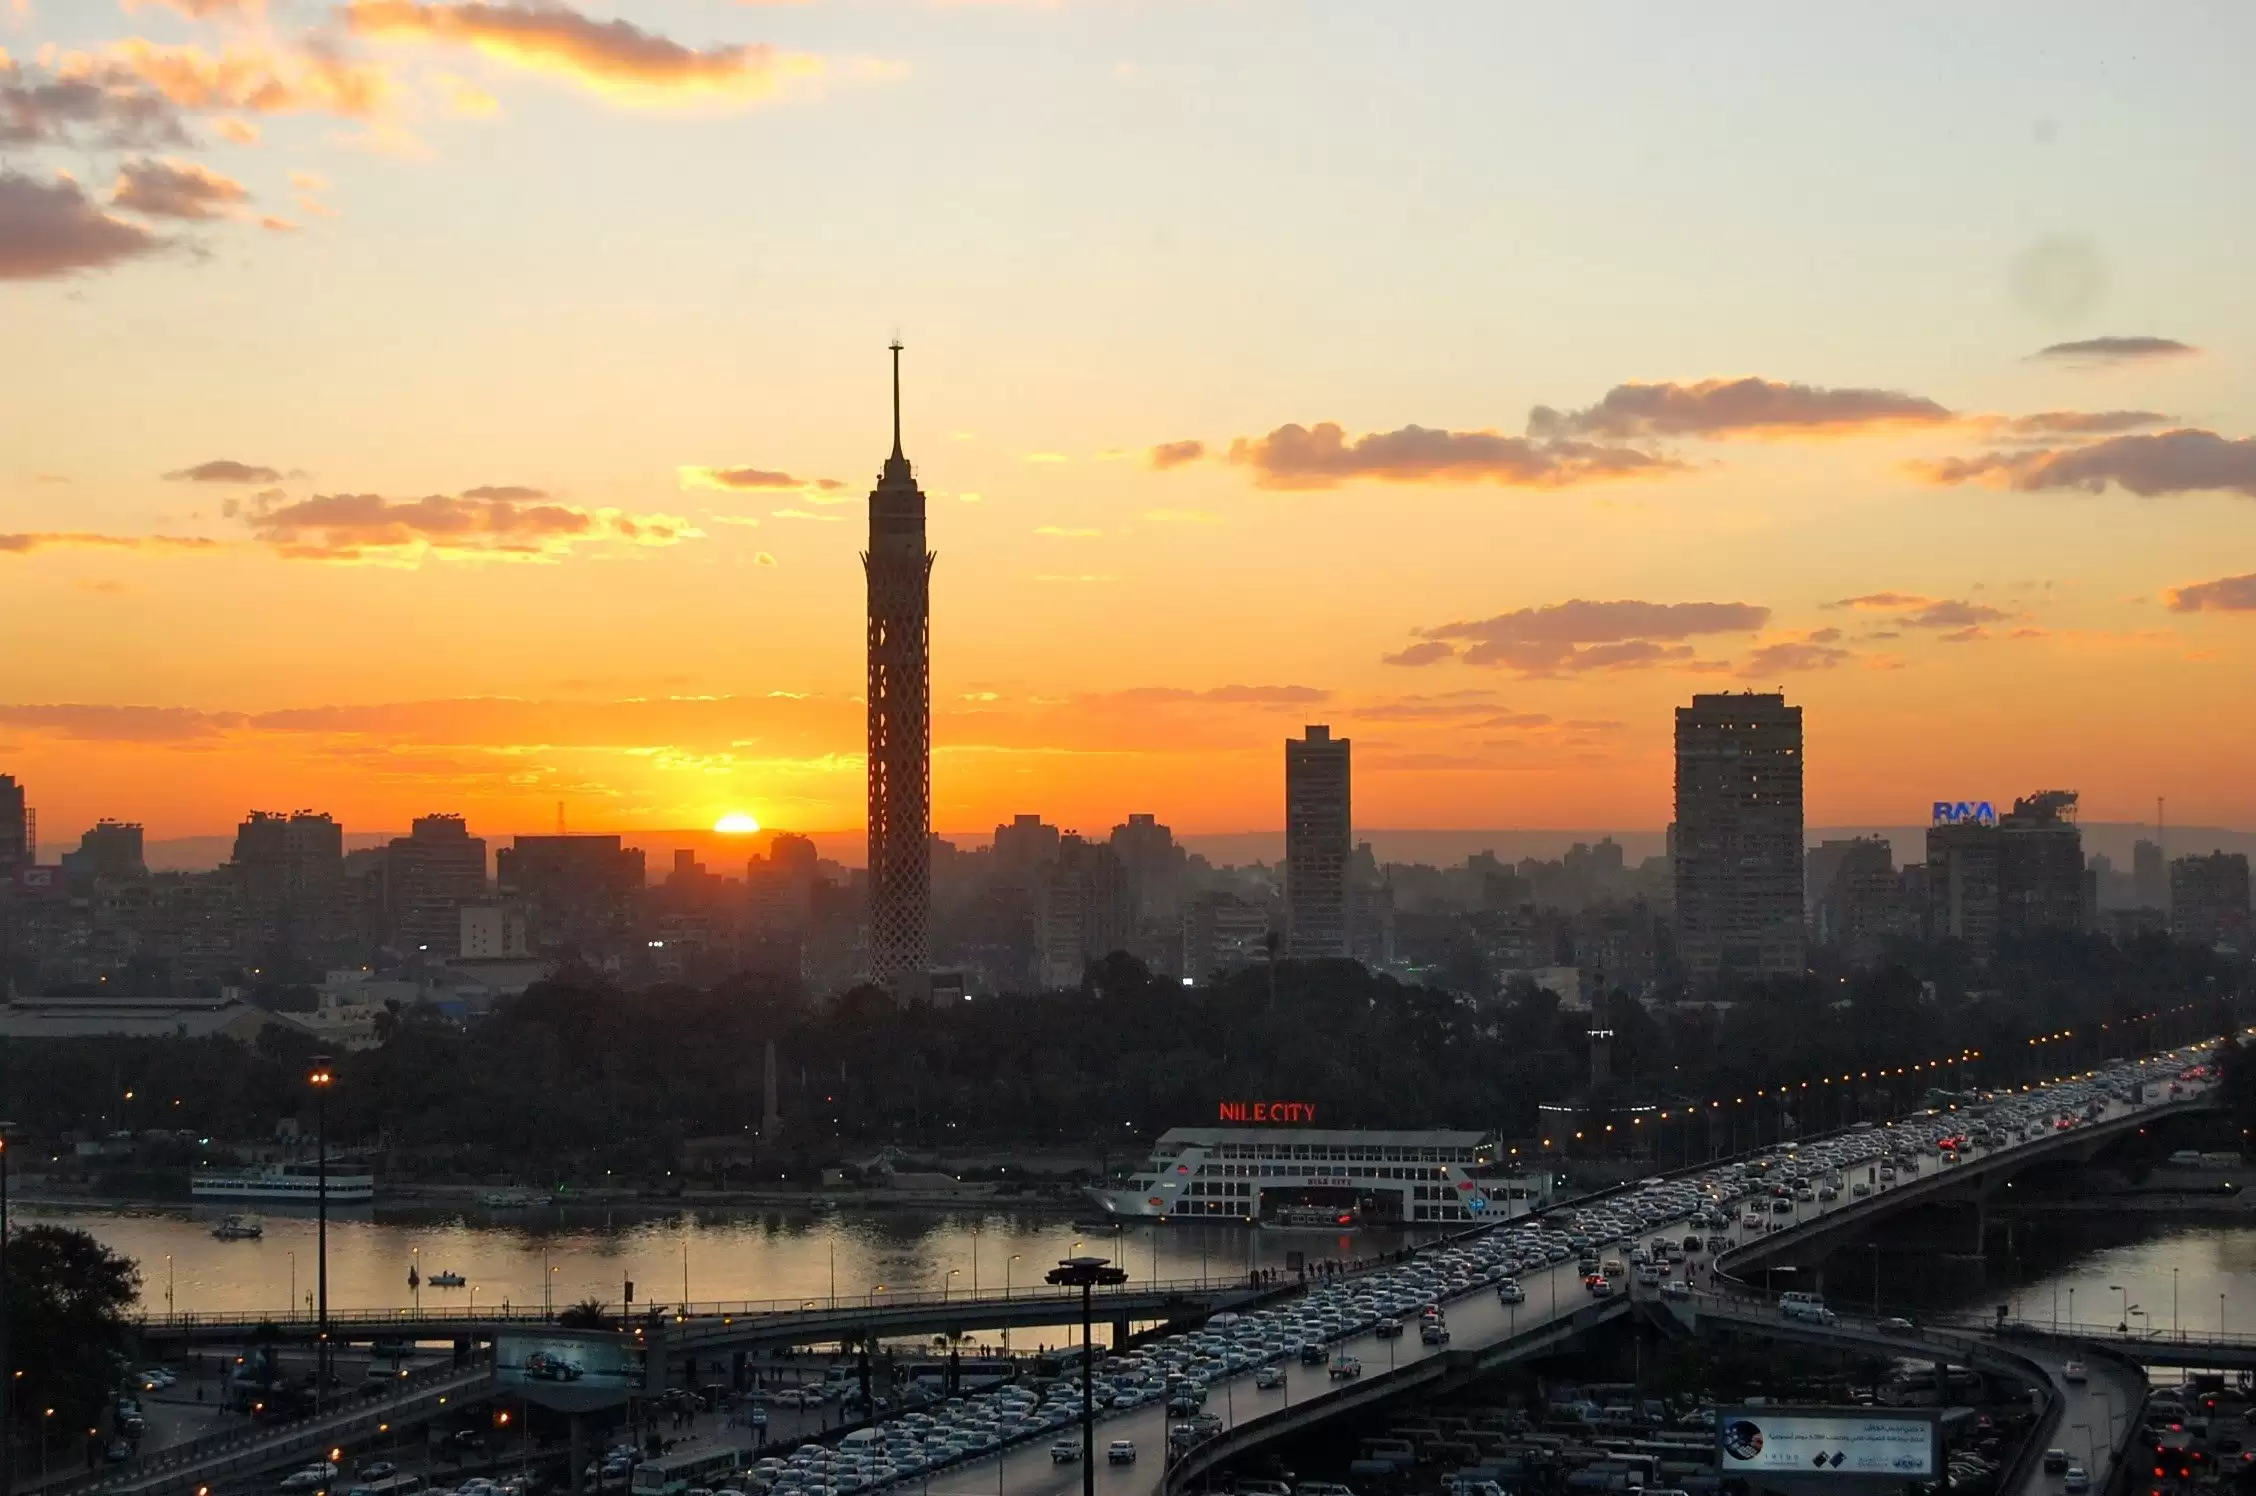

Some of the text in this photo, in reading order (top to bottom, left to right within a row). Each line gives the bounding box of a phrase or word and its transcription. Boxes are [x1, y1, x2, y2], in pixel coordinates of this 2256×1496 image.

[1934, 802, 1992, 820] RAA
[1220, 1103, 1315, 1121] NILE CITY
[1308, 1178, 1351, 1186] NILE CITY
